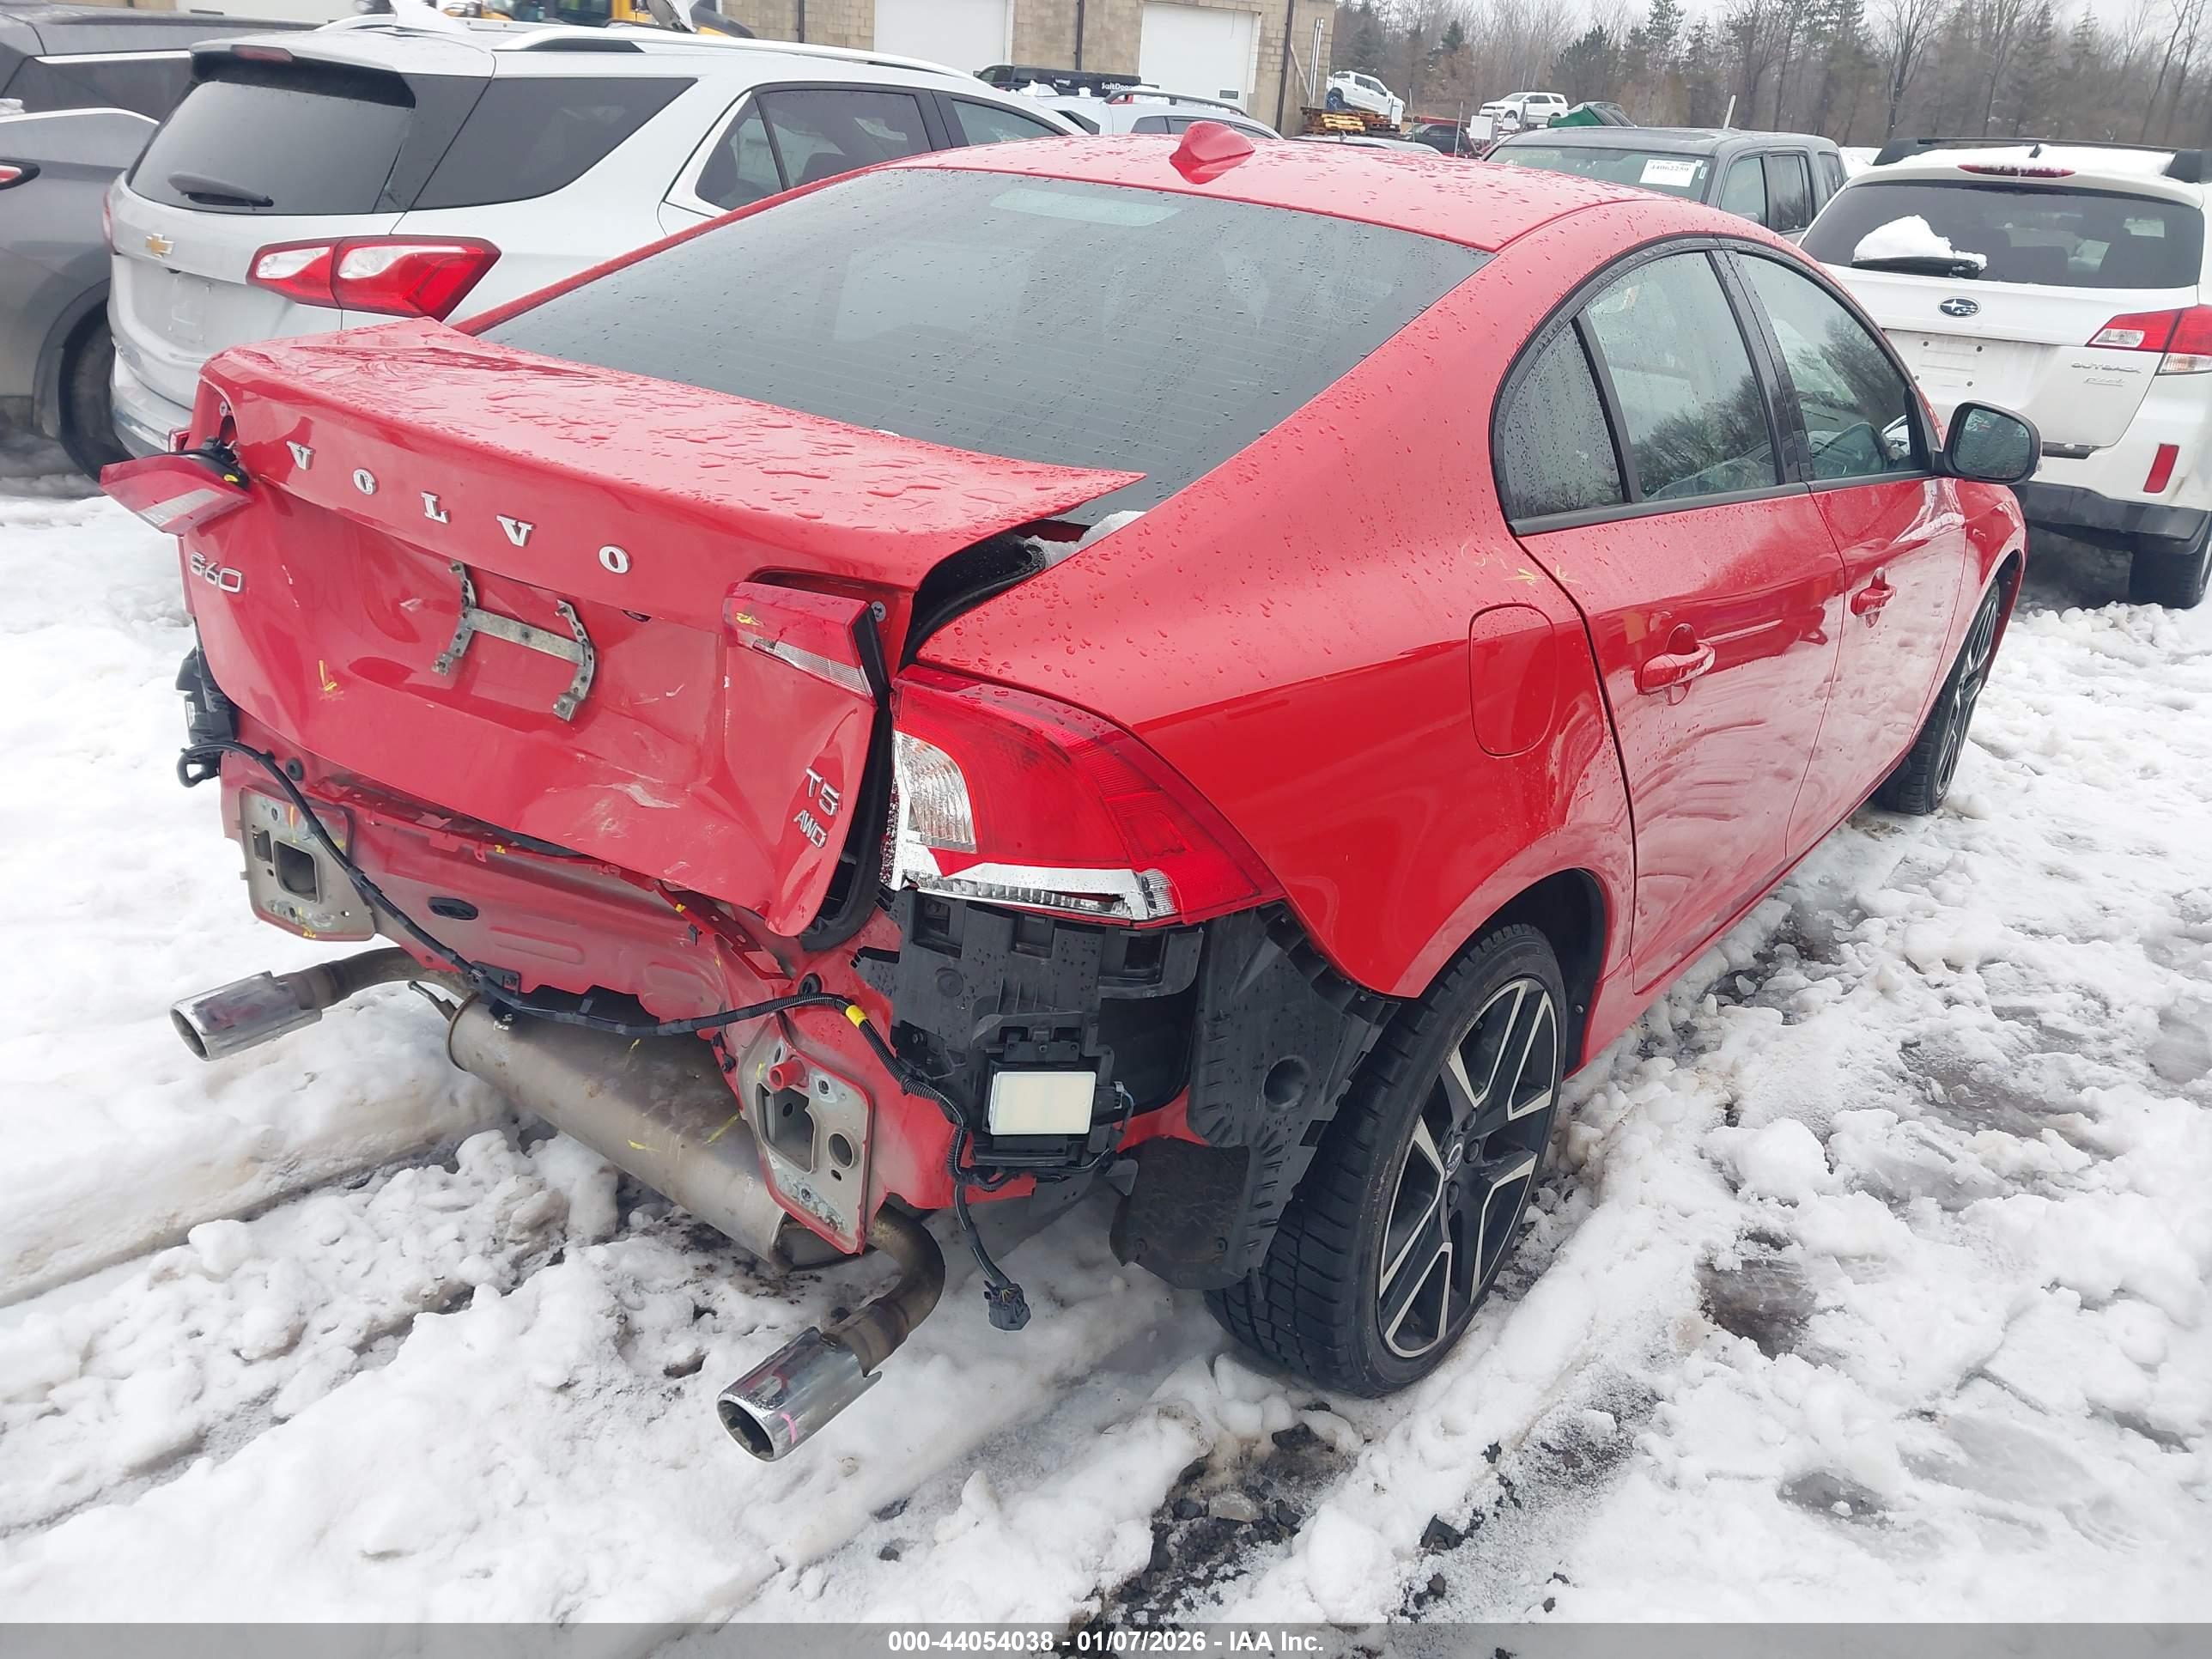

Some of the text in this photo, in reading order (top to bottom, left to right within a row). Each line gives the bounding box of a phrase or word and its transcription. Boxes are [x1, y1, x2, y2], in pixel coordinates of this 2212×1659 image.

[286, 441, 632, 574] VOLVO
[191, 550, 245, 593] S60
[805, 767, 841, 816] T5
[793, 809, 828, 848] AWD
